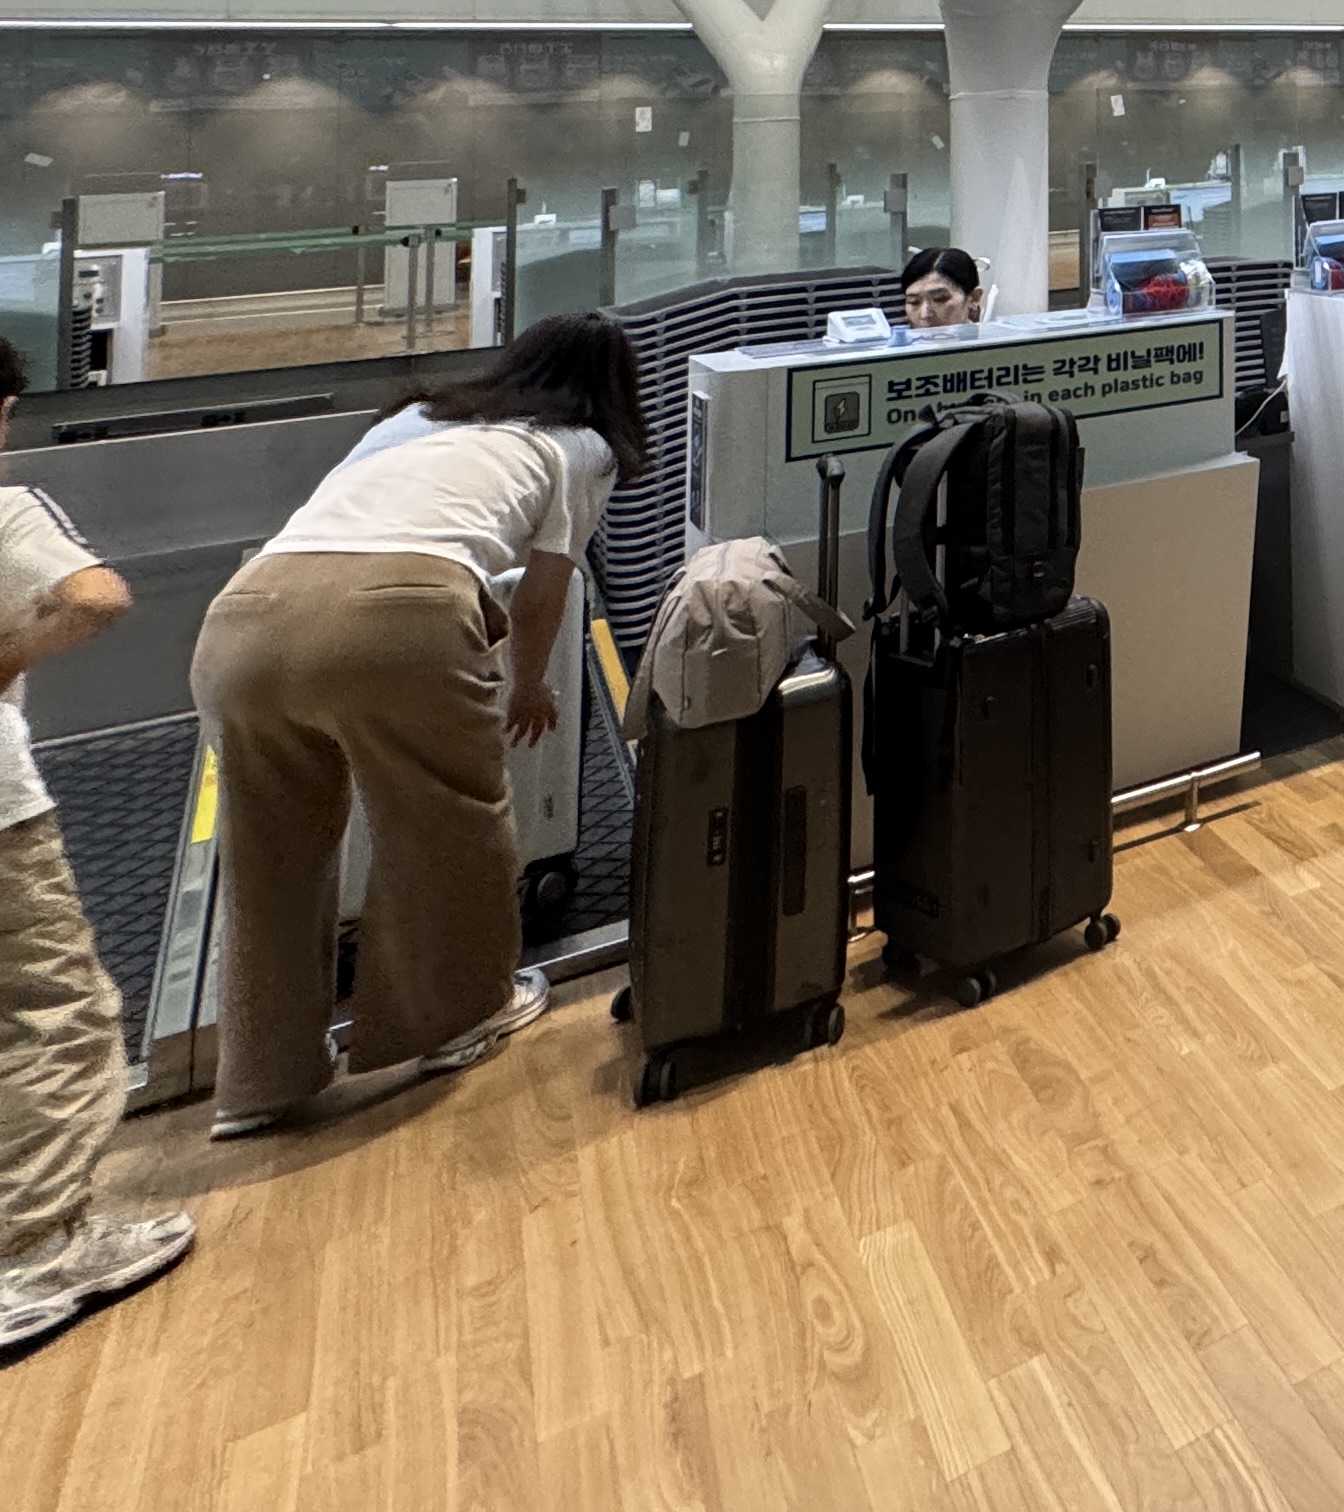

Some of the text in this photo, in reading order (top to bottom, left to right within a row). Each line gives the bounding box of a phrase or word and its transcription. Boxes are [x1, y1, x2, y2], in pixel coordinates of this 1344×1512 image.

[886, 341, 1205, 402] 보조배터리는 각각 비닐팩에!
[1043, 379, 1096, 402] each
[1102, 371, 1164, 397] plastic
[1170, 368, 1204, 386] bag
